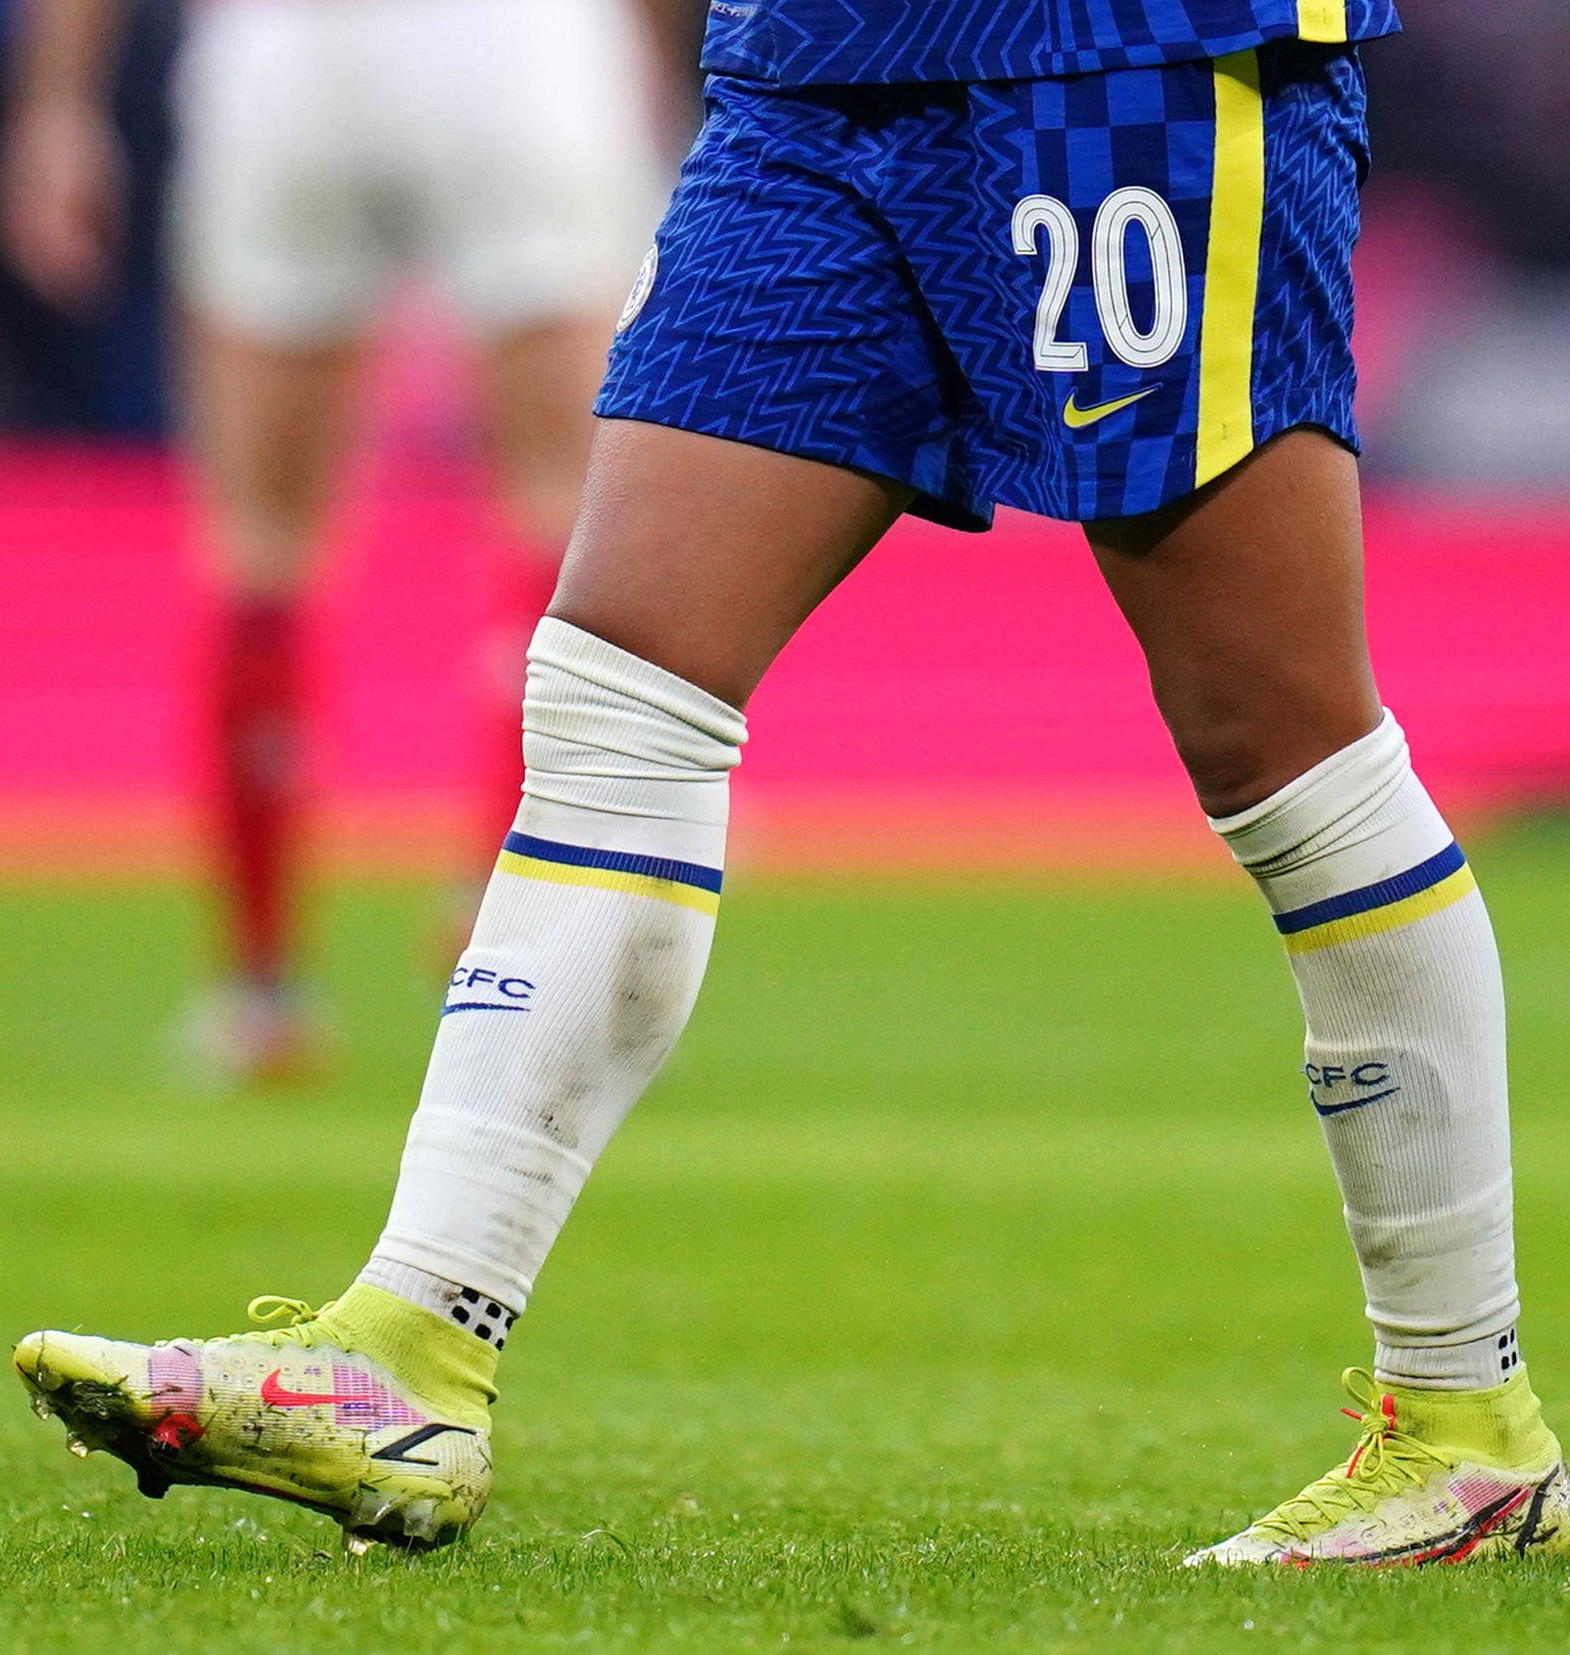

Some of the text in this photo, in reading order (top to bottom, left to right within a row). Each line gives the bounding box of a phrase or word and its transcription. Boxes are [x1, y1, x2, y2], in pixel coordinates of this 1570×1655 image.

[1011, 186, 1188, 372] 20
[450, 967, 535, 999] CFC
[1306, 1062, 1390, 1087] CFC
